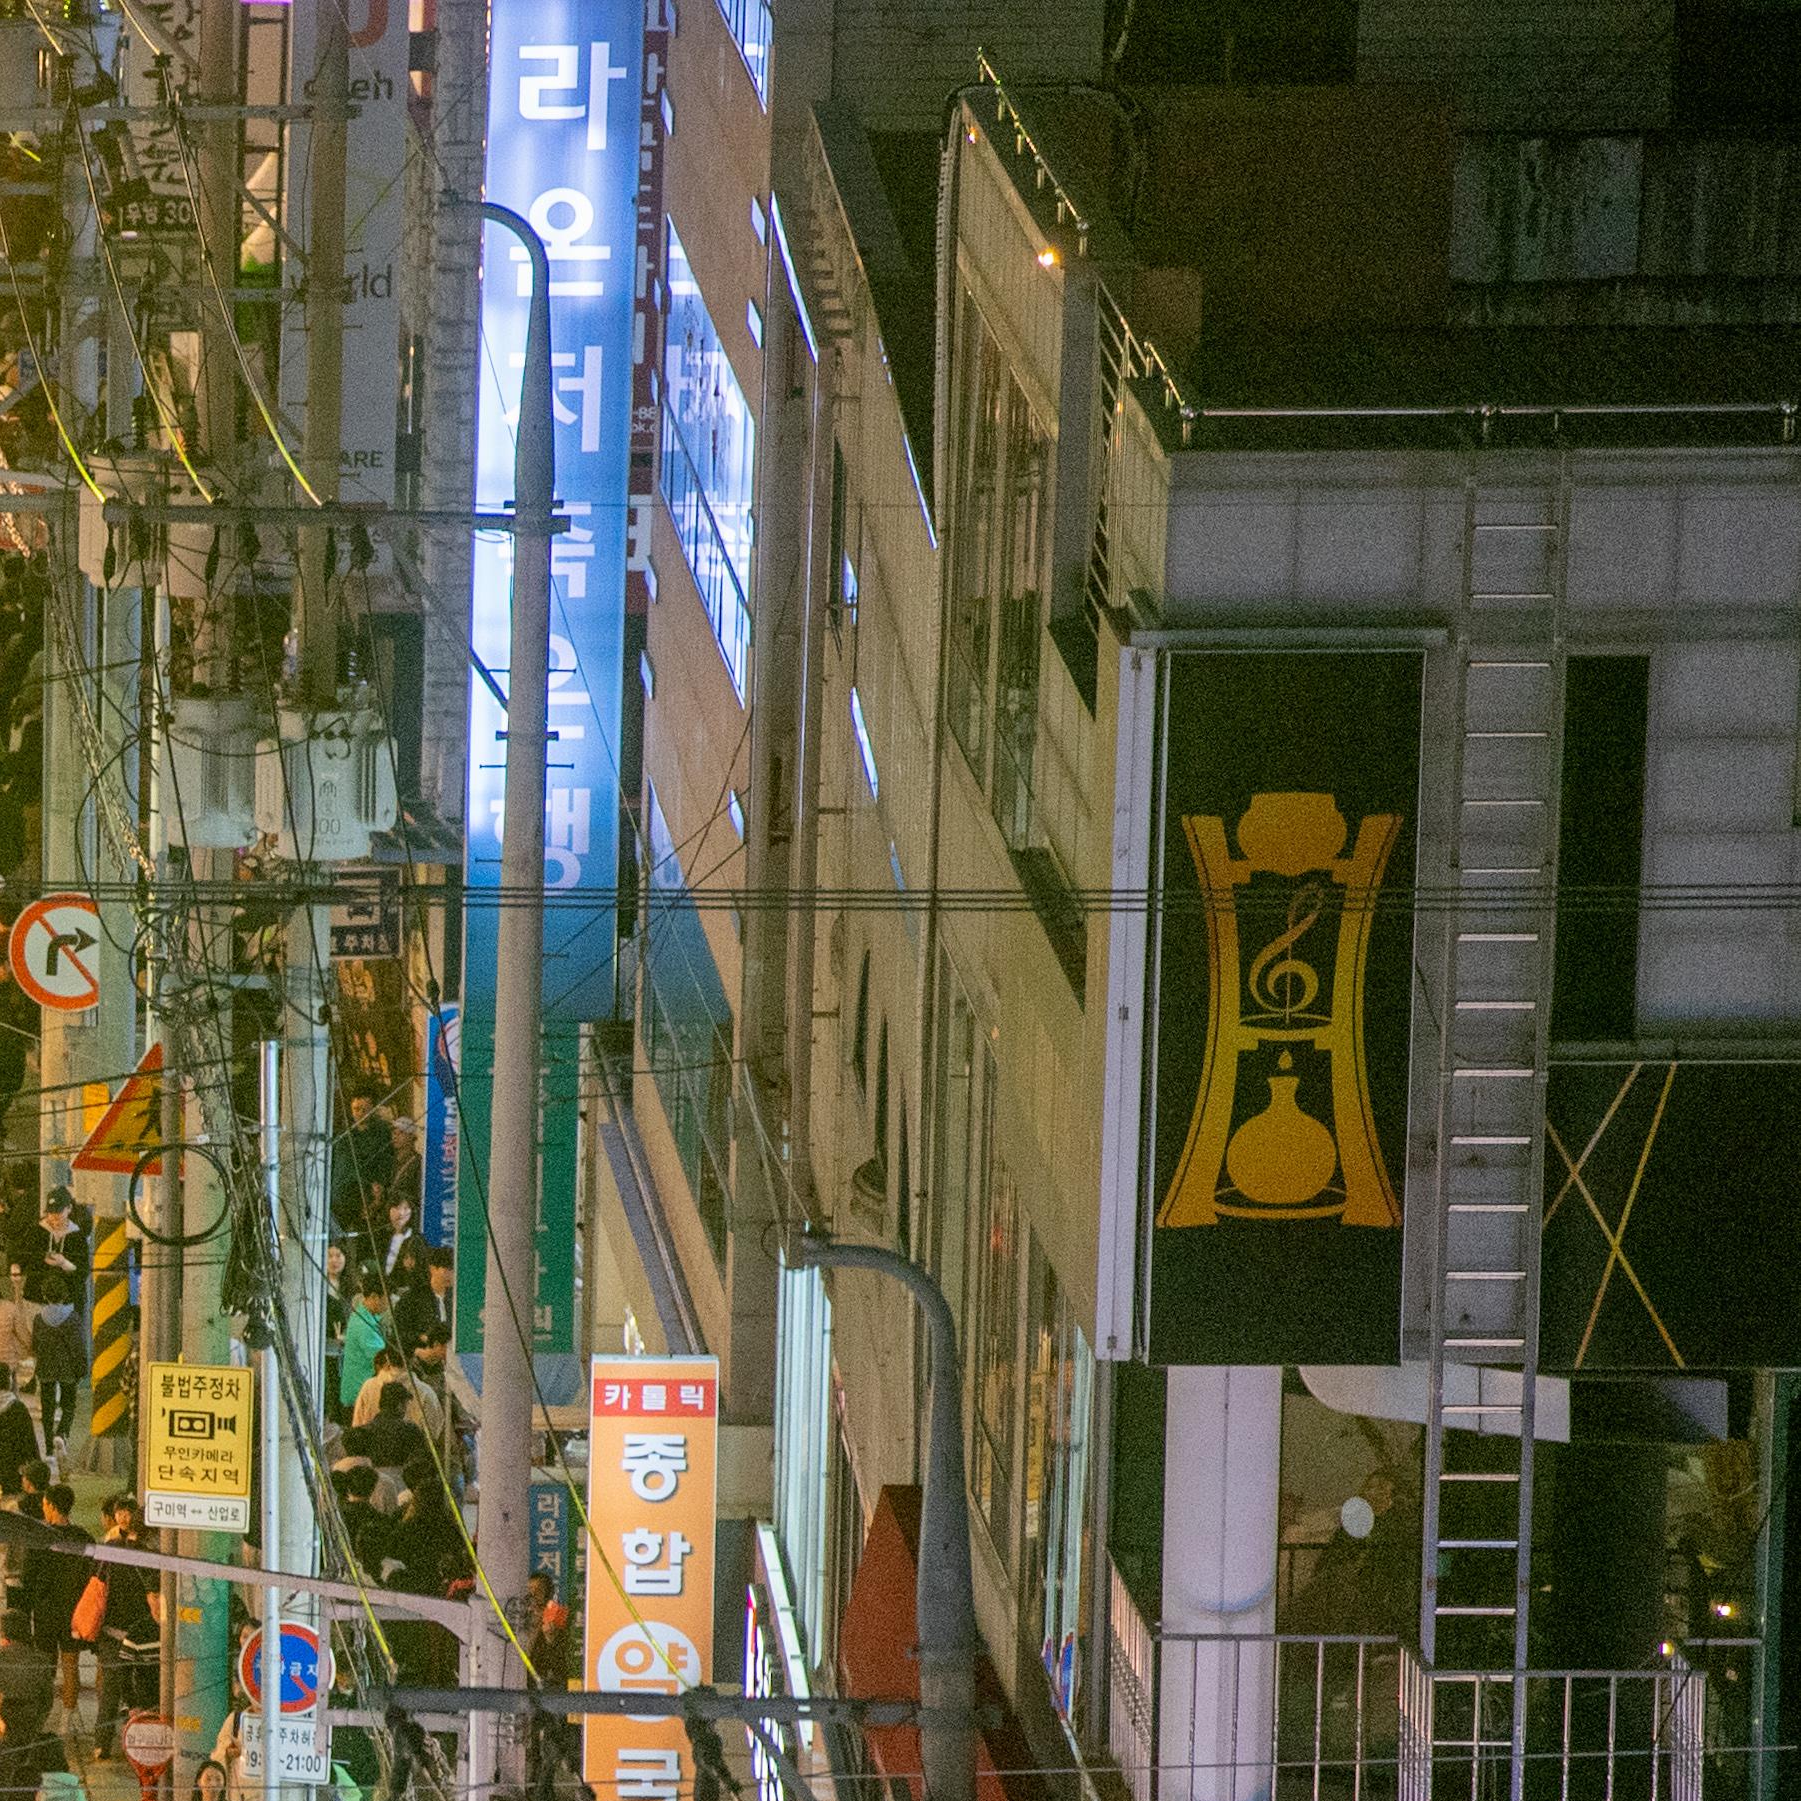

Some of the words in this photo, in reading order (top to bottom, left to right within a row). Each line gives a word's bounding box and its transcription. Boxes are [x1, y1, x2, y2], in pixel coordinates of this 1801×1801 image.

[160, 1374, 241, 1402] 불법주정차
[163, 1446, 234, 1464] 무인카메라
[158, 1464, 240, 1486] 단속지역
[153, 1500, 188, 1520] 구미역
[207, 1504, 241, 1523] 산업로
[536, 1491, 562, 1582] 라온저
